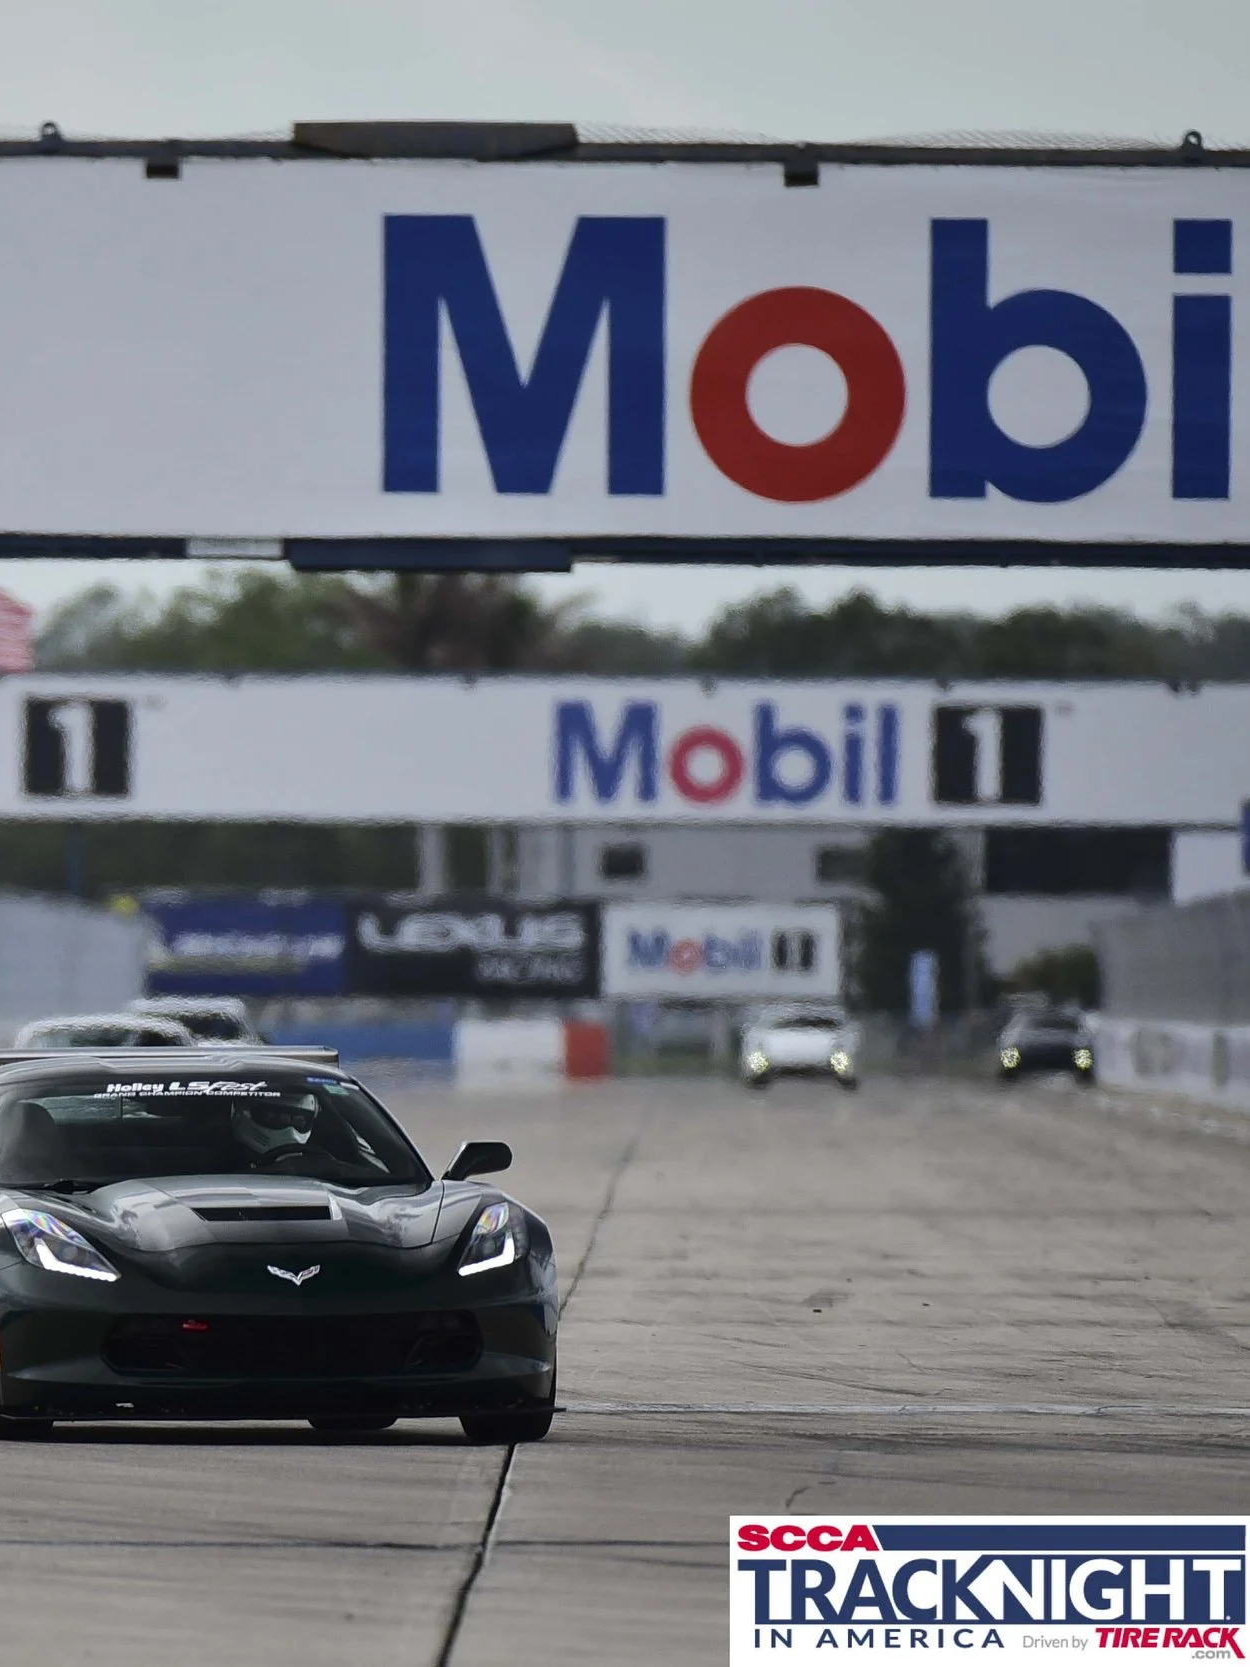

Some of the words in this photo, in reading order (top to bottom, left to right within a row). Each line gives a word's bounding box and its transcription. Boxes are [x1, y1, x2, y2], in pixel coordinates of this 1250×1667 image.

[382, 214, 1233, 504] Mobi
[554, 700, 900, 804] Mobil
[357, 912, 587, 953] LEXUS
[626, 924, 763, 976] Mobil
[93, 1091, 136, 1099] GRAND
[138, 1090, 203, 1098] CHAMPION
[205, 1090, 281, 1098] COMPETITOR
[107, 1083, 164, 1093] Holley
